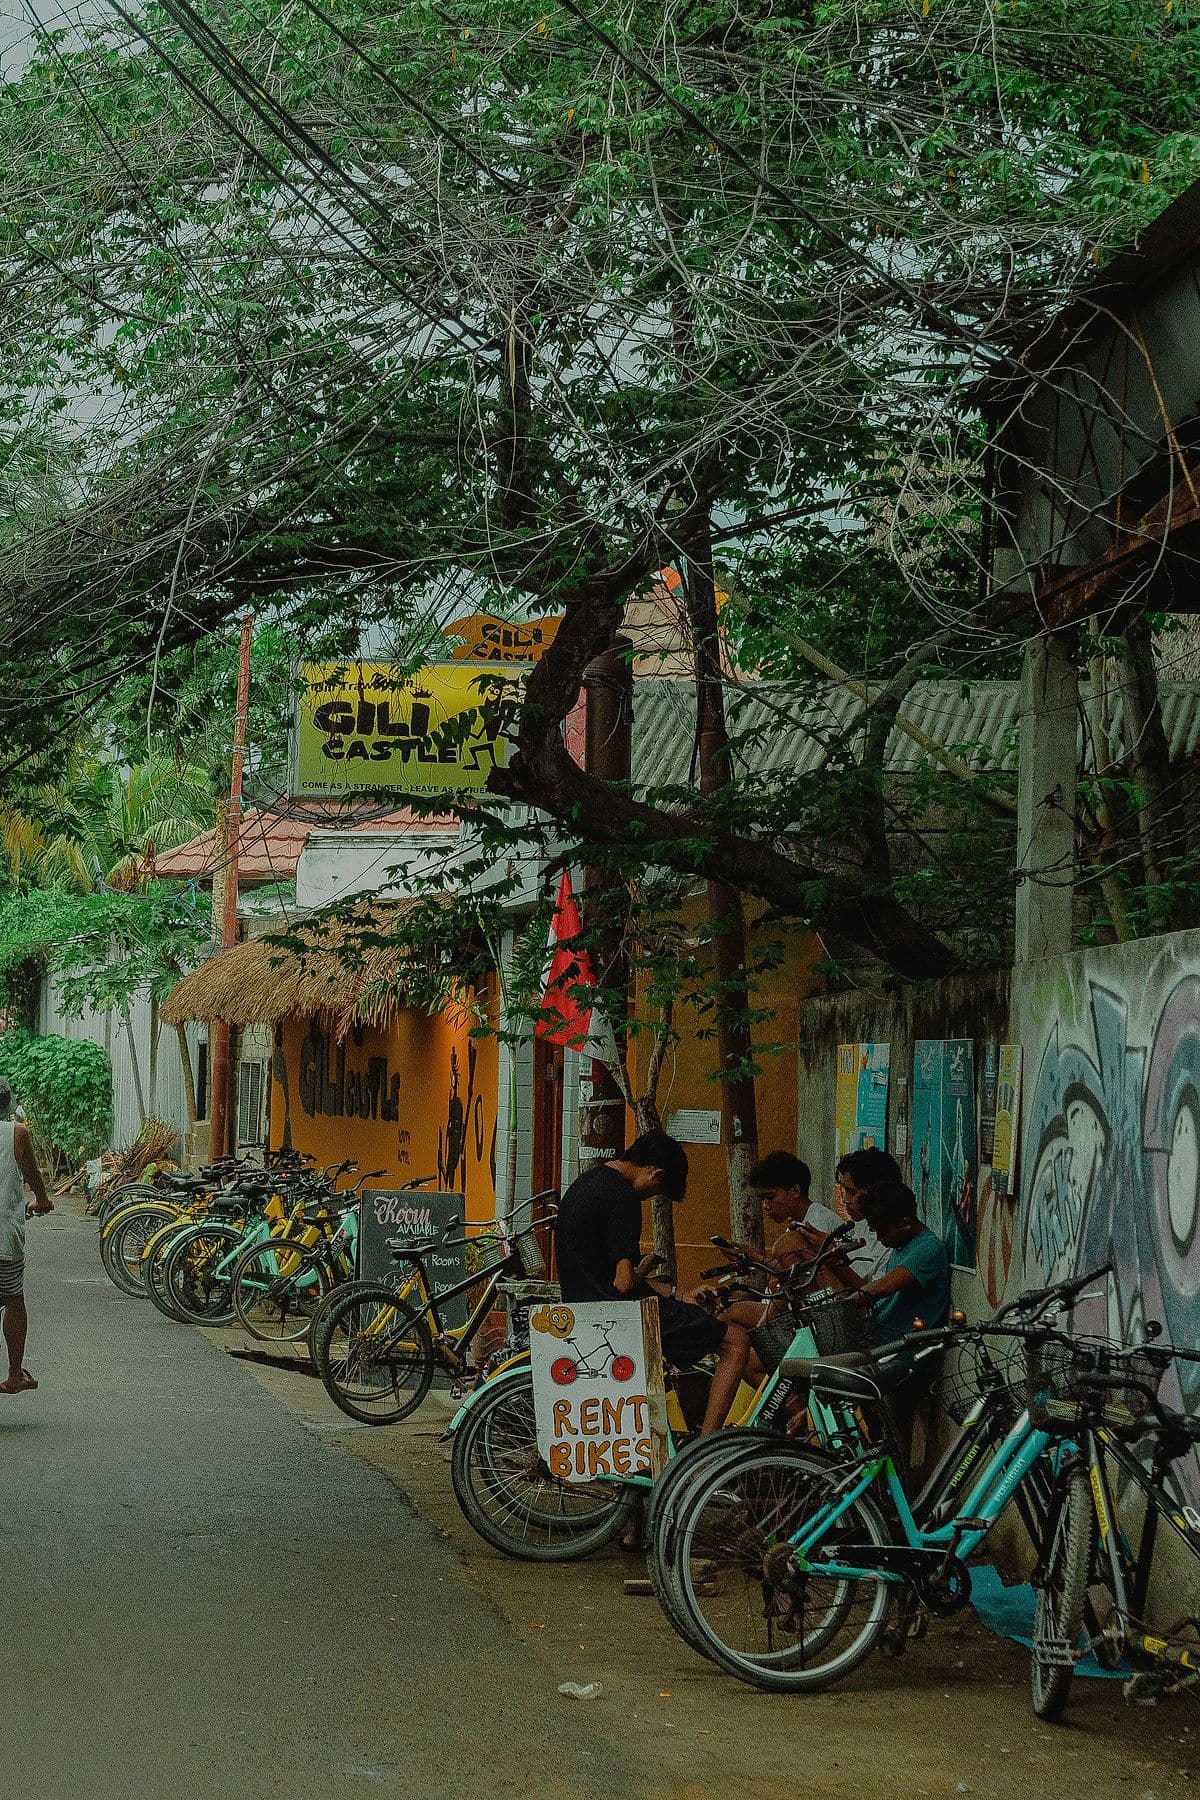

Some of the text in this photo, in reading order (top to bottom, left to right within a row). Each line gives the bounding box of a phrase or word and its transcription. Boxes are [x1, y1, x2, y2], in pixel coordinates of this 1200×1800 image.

[481, 623, 542, 646] GILI
[313, 700, 430, 737] GILI
[322, 740, 457, 763] CASTLE
[302, 781, 328, 789] COME
[330, 782, 342, 790] AS
[411, 785, 439, 793] LEAVE
[442, 786, 453, 794] AS
[553, 1395, 647, 1438] RENT
